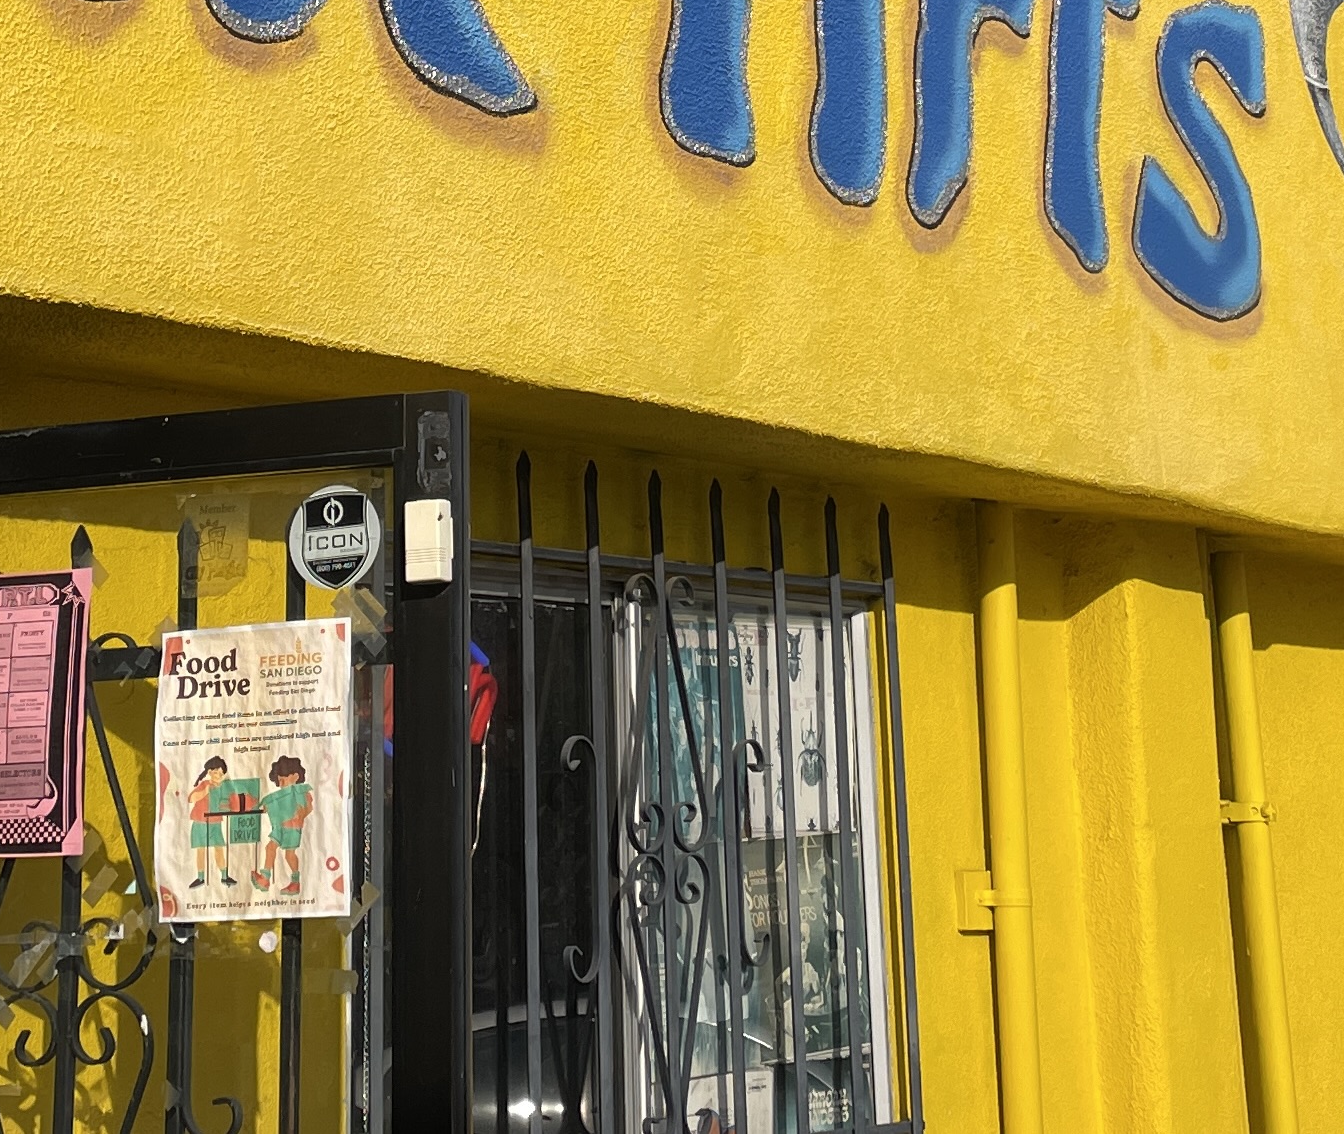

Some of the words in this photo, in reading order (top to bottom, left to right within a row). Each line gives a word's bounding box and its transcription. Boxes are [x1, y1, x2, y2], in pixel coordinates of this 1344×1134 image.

[308, 531, 364, 552] ICON
[169, 648, 238, 676] Food
[259, 651, 323, 668] FEEDING
[259, 668, 283, 679] SAN
[285, 665, 323, 677] DIEGO
[176, 673, 251, 700] Drive
[237, 816, 255, 828] FOOD
[233, 828, 256, 842] DRIVE
